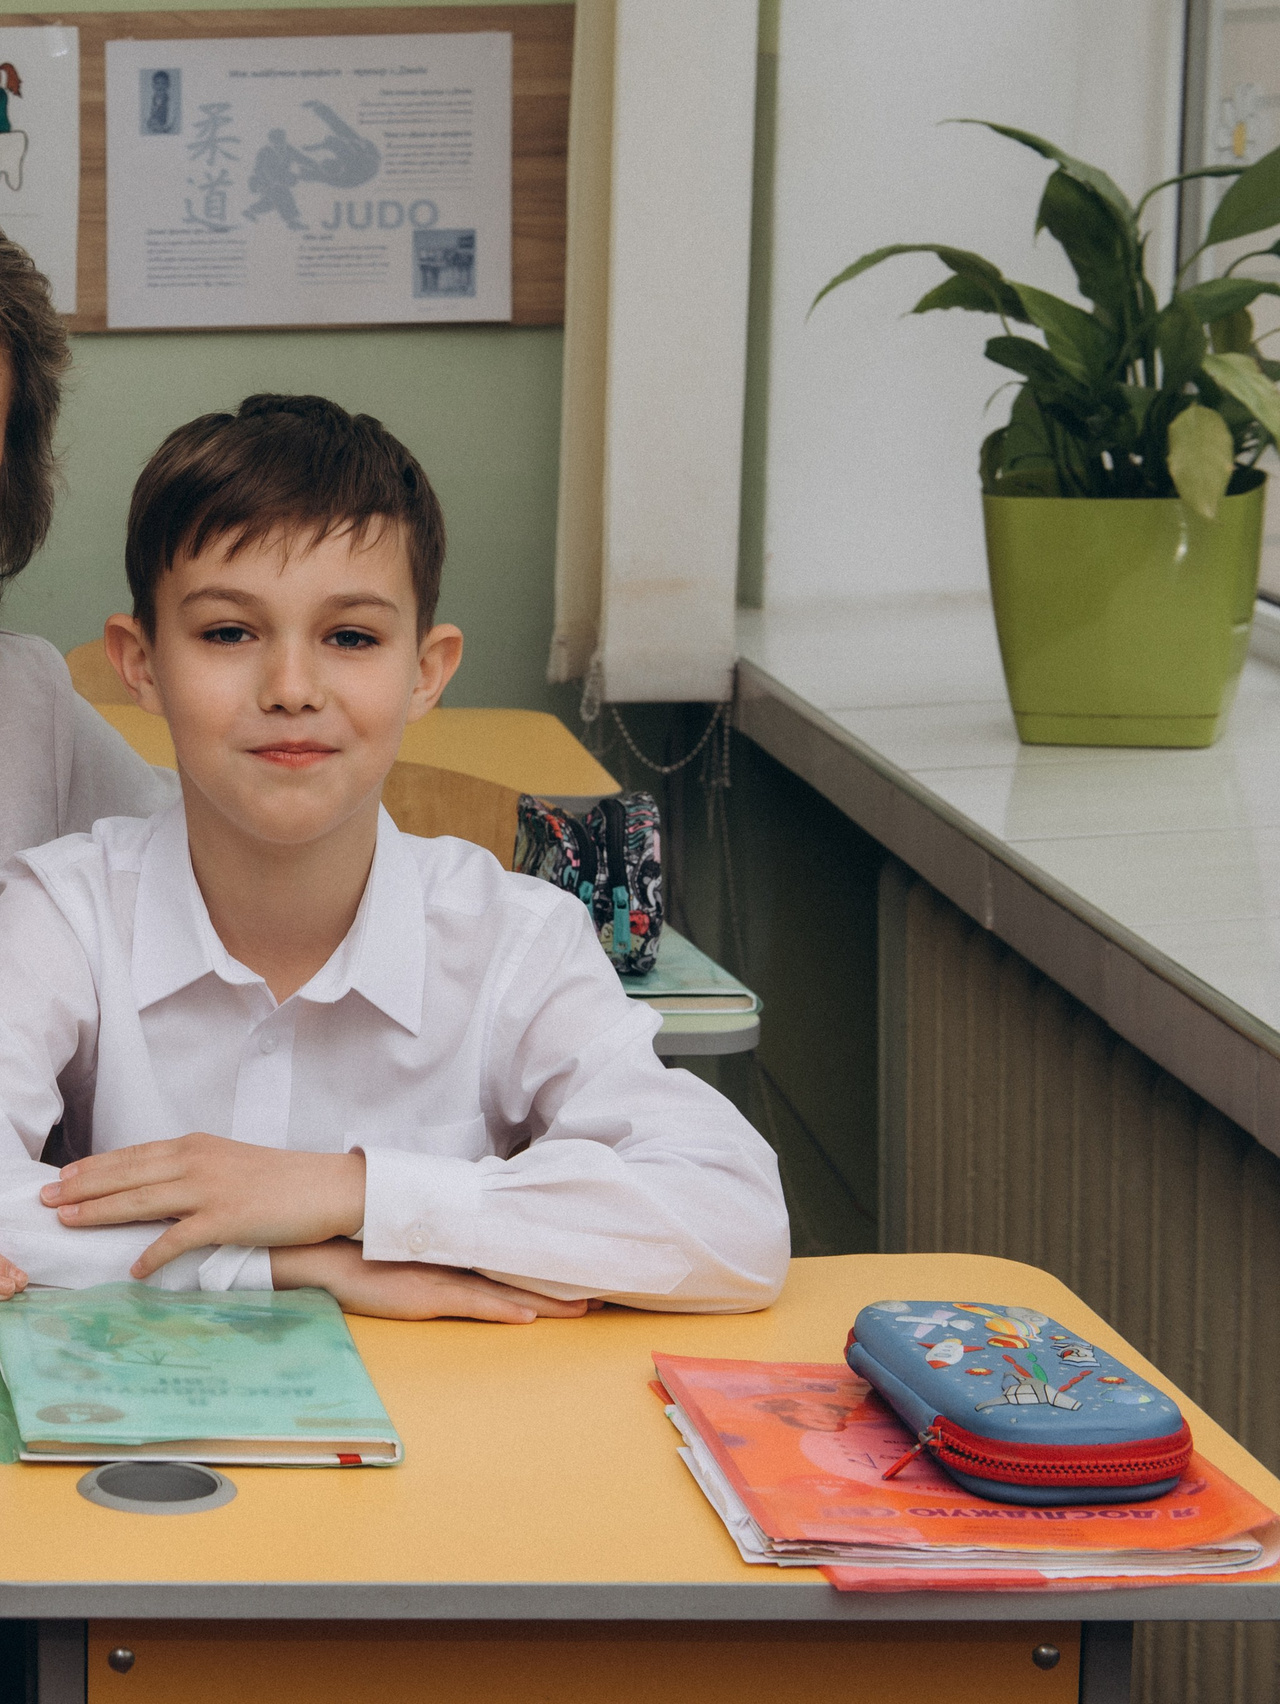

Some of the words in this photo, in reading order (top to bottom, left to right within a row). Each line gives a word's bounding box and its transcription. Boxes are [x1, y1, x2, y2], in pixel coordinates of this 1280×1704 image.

[321, 198, 439, 231] JUDO
[908, 1505, 1160, 1520] ДОСЛІДЖУЮ
[1170, 1506, 1200, 1519] Я
